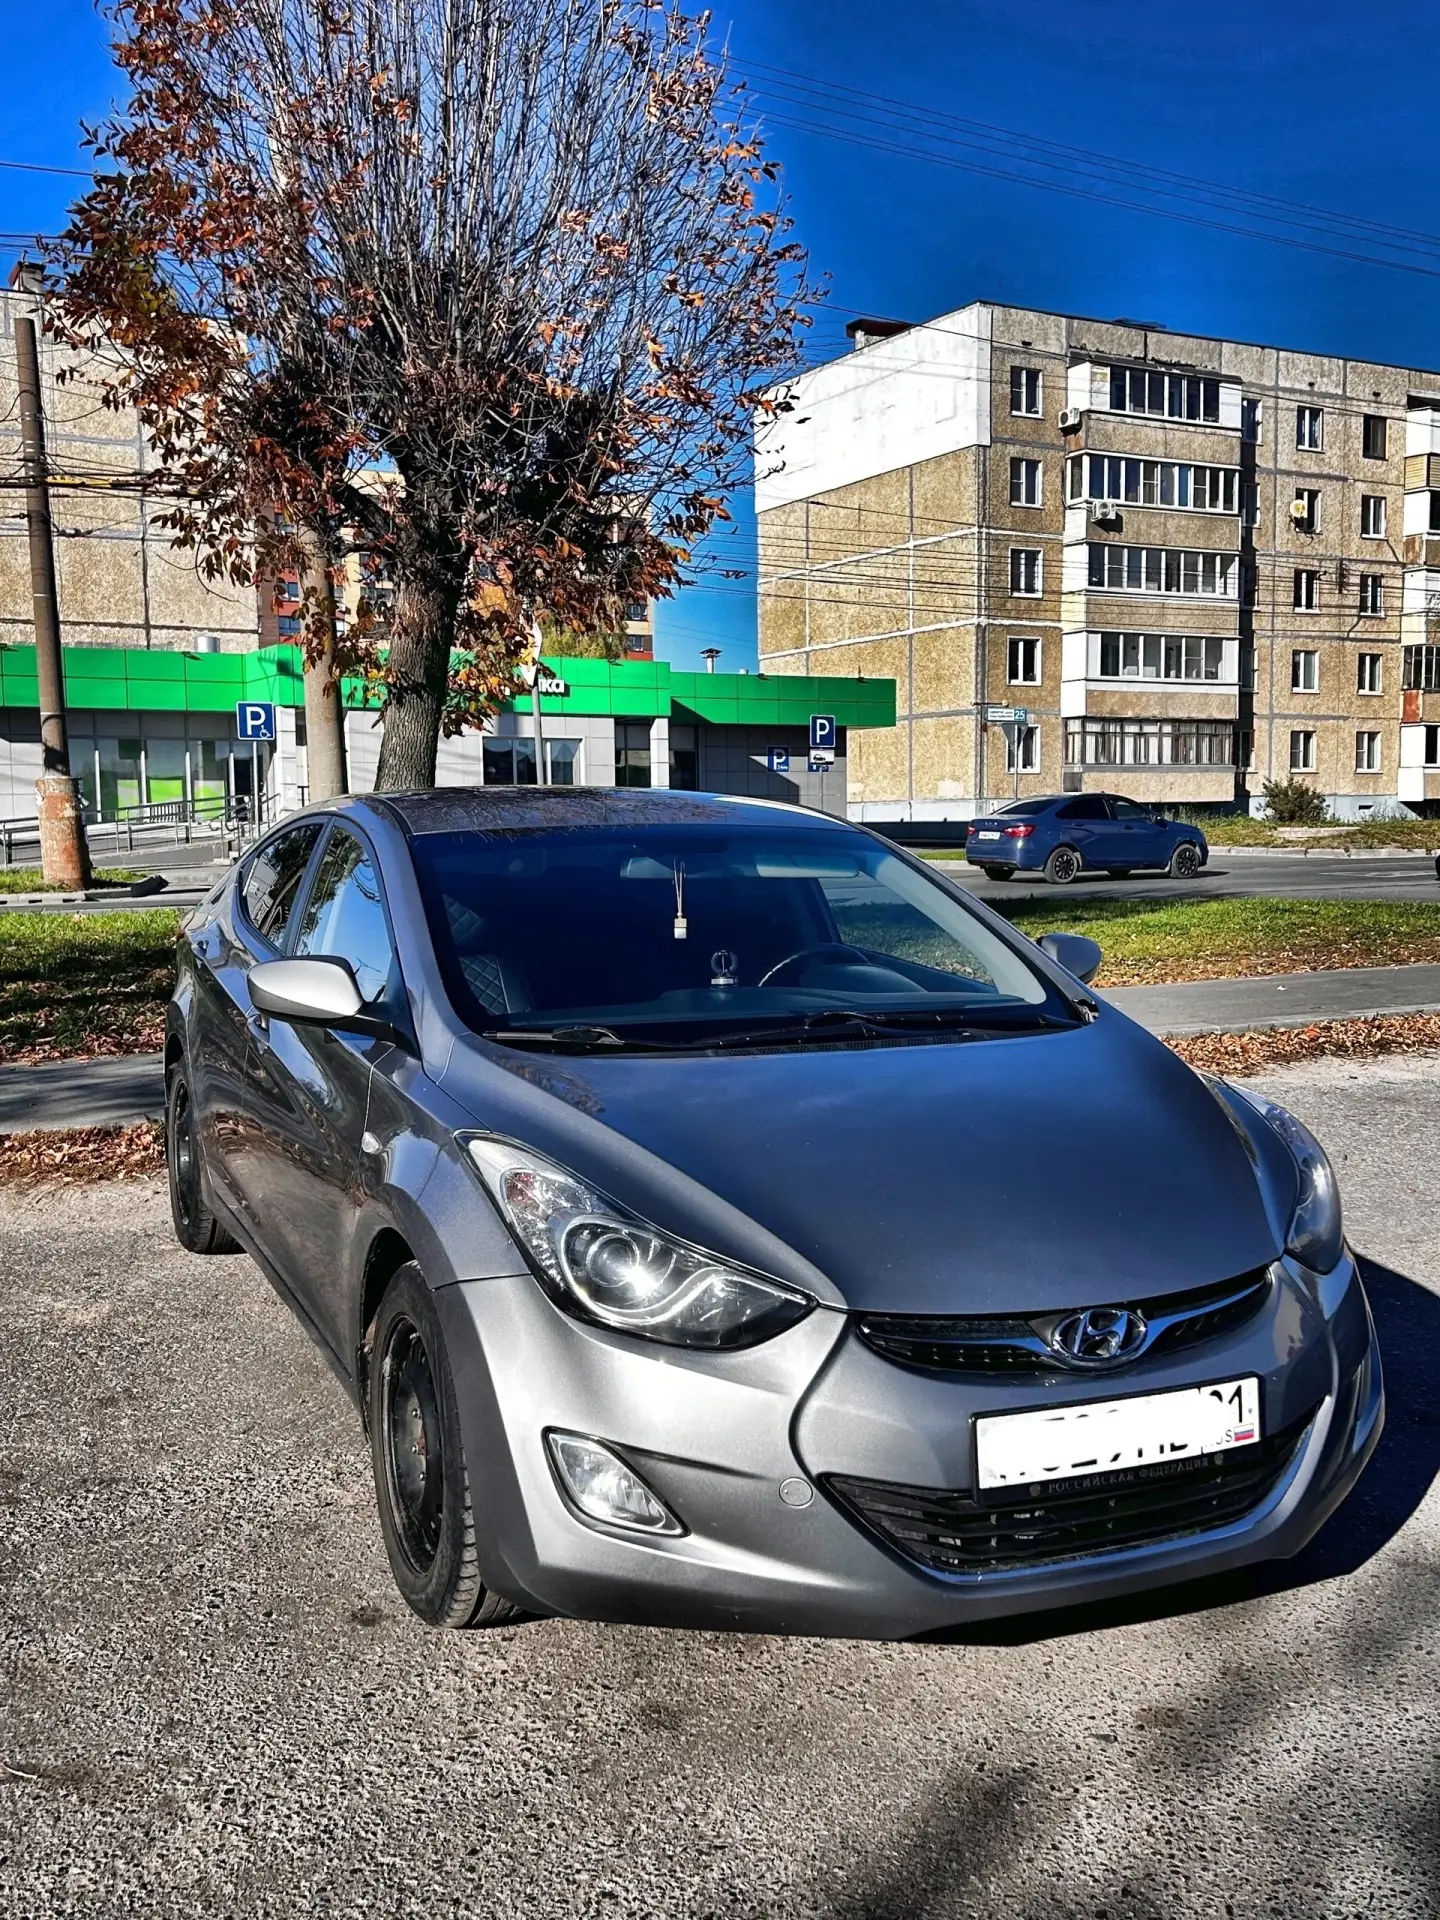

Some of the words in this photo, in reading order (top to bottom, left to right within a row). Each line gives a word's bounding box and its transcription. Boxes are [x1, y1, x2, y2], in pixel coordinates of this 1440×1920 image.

[246, 706, 266, 736] P
[1015, 711, 1025, 720] 25
[816, 719, 830, 743] P
[773, 748, 786, 770] P
[1048, 1471, 1135, 1493] РОССИЙСКАЯ
[1139, 1456, 1209, 1478] ФЕДЕРАЦИЯ
